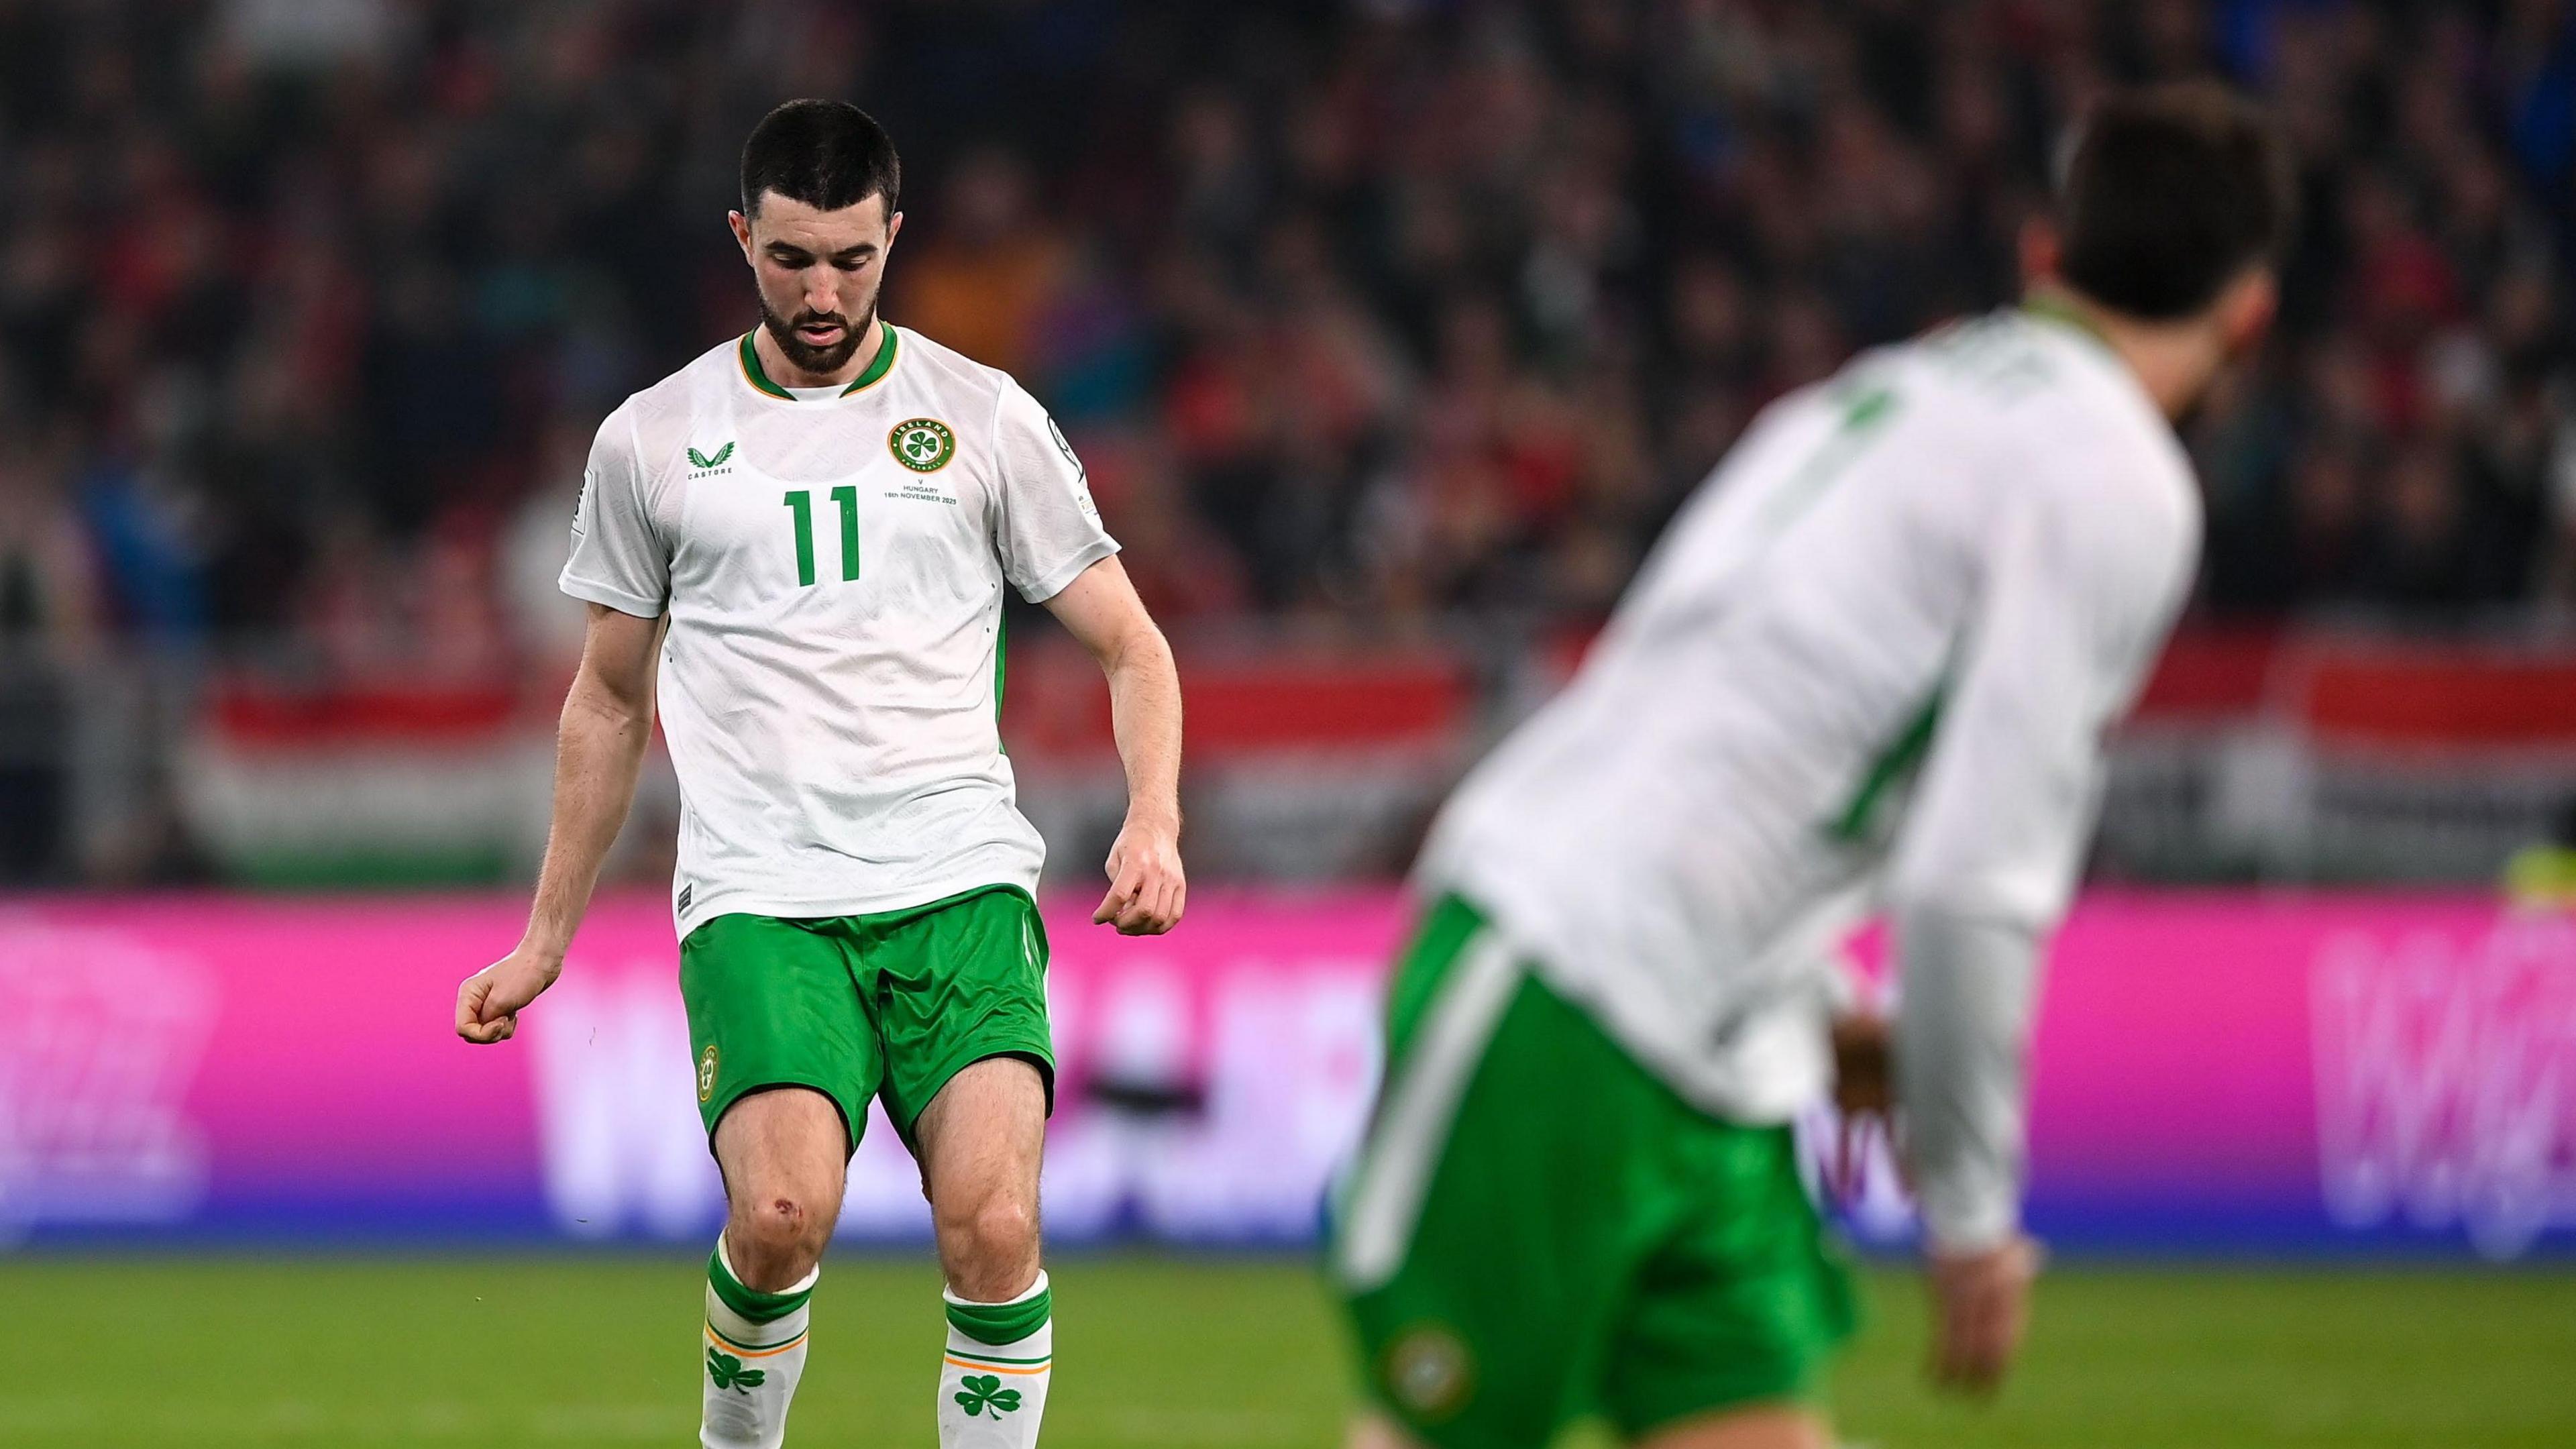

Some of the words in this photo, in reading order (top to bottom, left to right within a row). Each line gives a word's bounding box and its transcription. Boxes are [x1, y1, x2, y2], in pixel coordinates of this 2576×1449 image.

[895, 421, 948, 437] IRELAND
[688, 468, 732, 480] CASTORE
[903, 485, 938, 494] HUNGARY
[900, 492, 941, 502] NOVEMBER
[784, 486, 859, 587] 11
